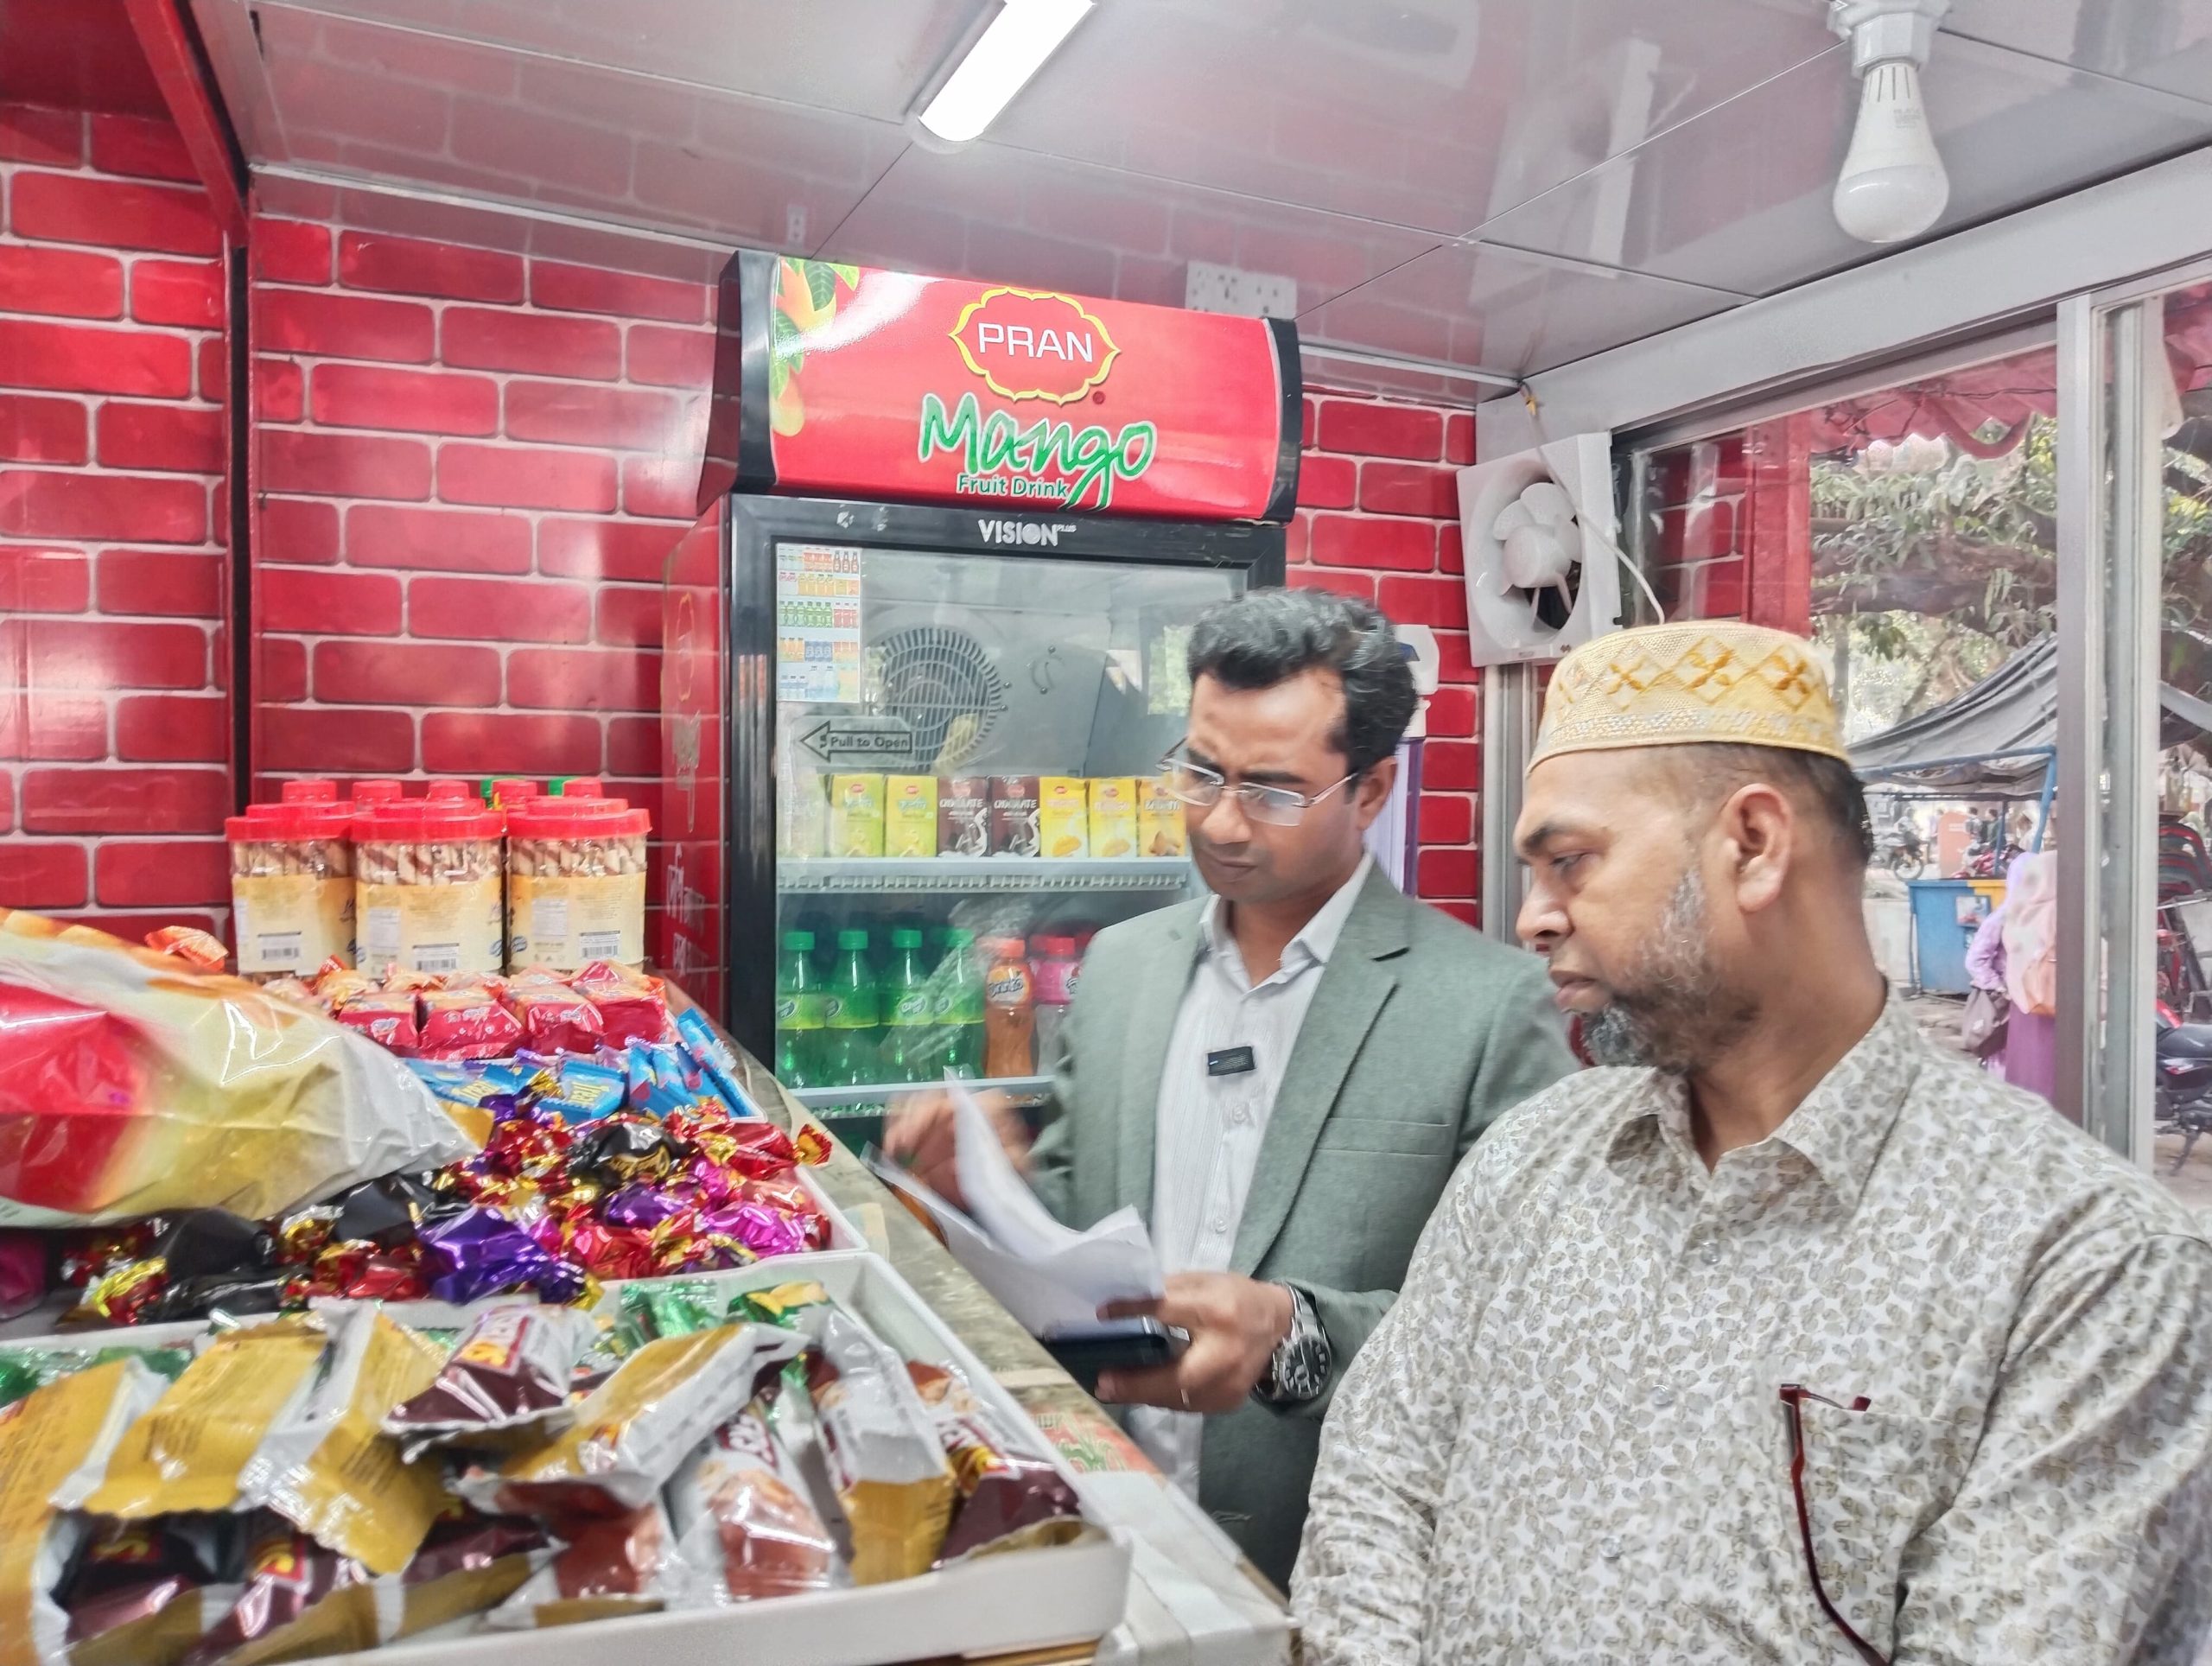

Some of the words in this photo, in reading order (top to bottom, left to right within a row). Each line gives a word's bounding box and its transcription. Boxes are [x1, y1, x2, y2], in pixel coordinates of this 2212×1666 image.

[977, 321, 1093, 363] PRAN
[918, 392, 1156, 512] Mango
[957, 474, 1007, 496] Fruit
[1012, 476, 1070, 499] Drink
[977, 519, 1058, 547] VISION
[830, 735, 854, 747] Pull
[856, 736, 871, 747] to
[874, 736, 908, 749] Open
